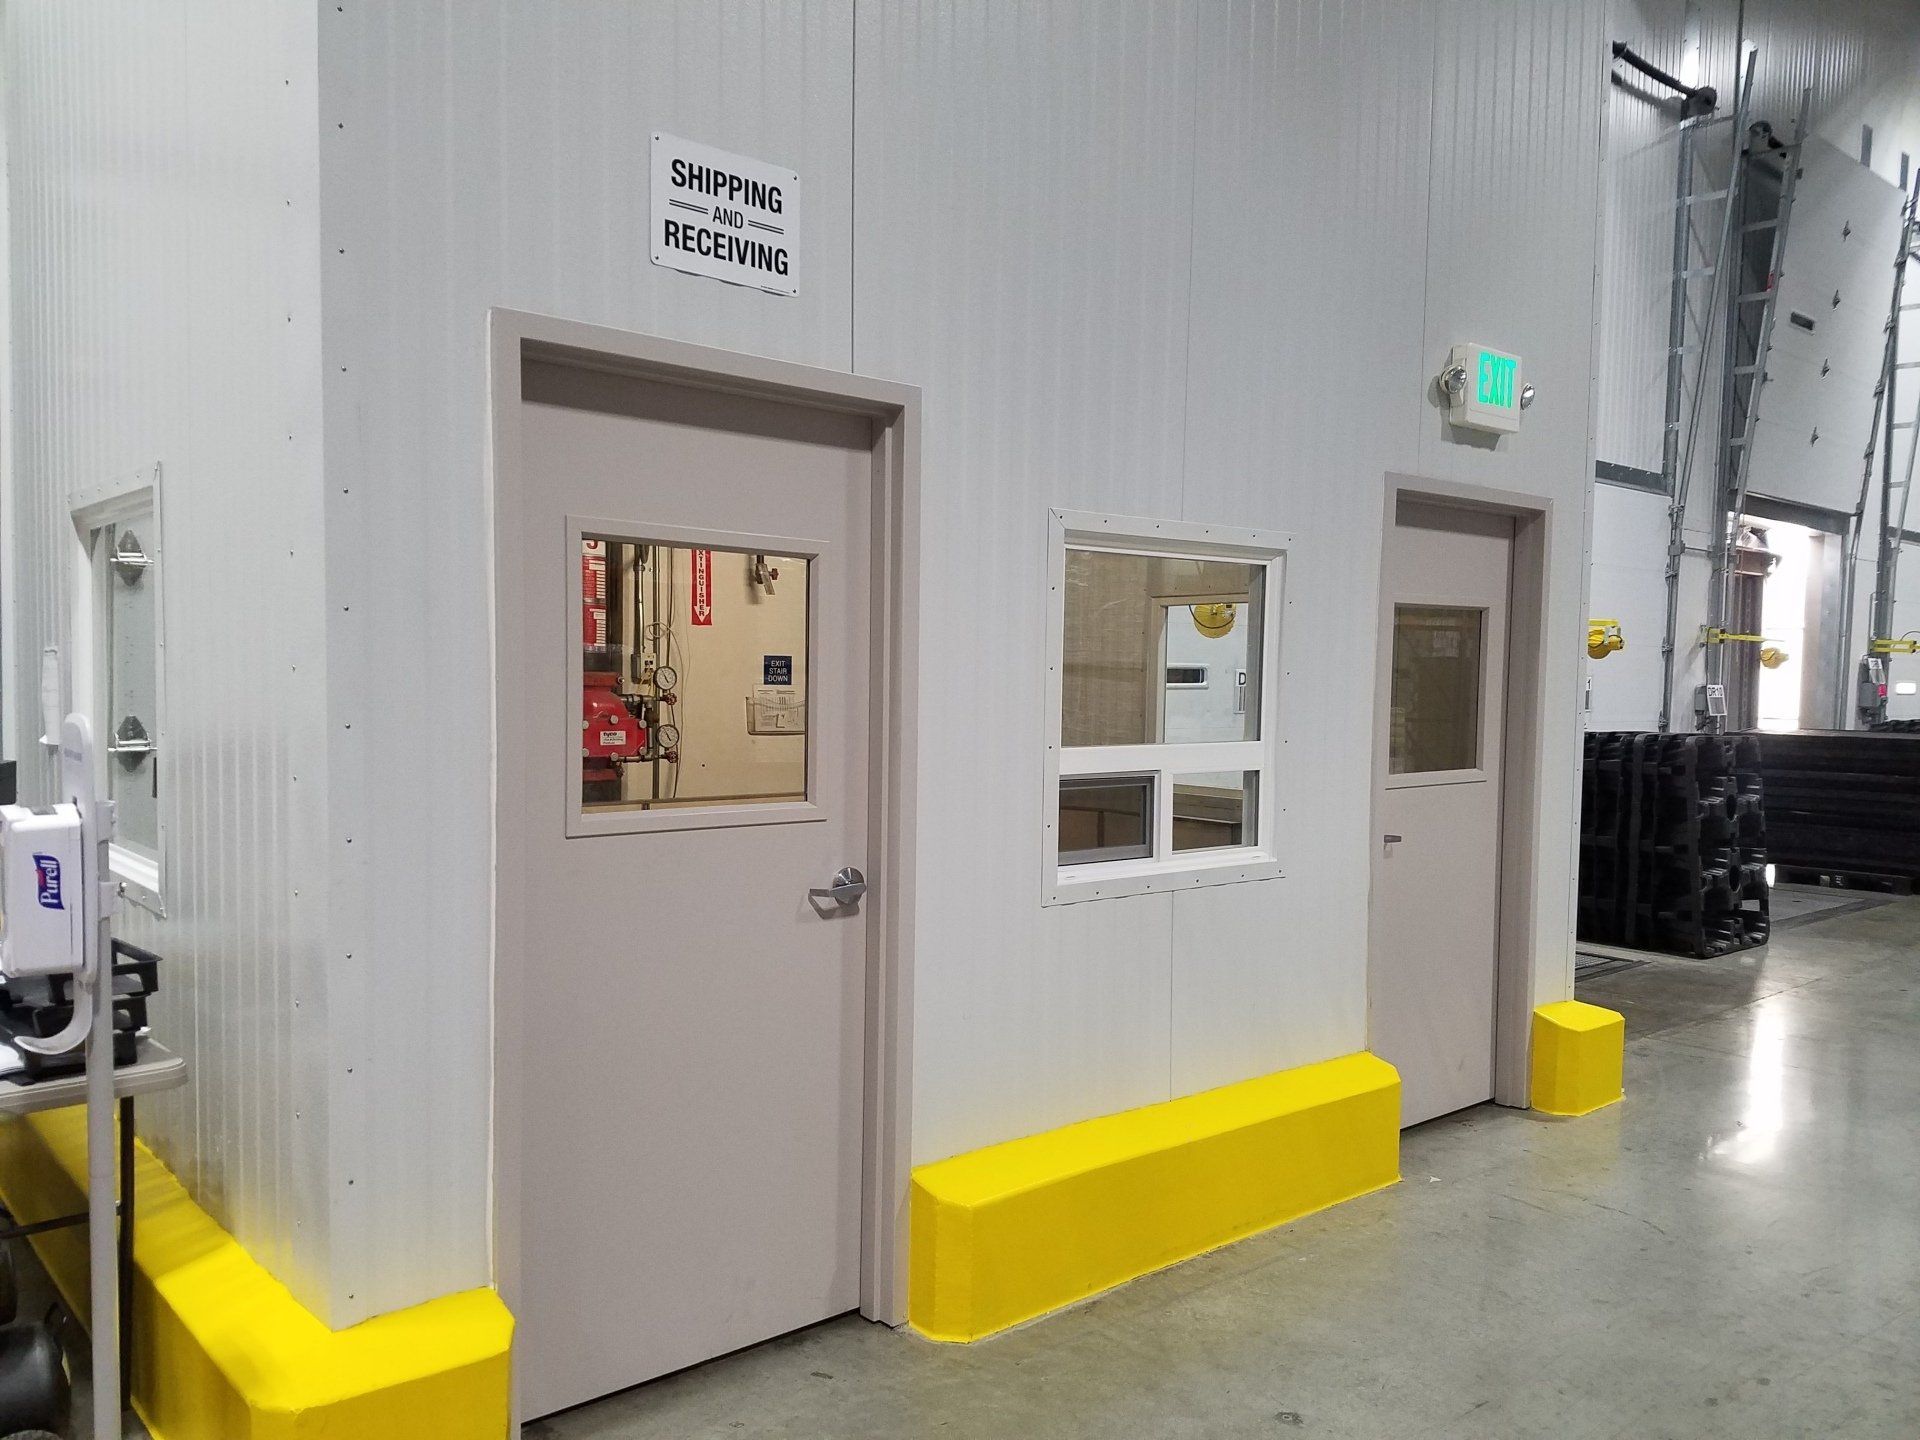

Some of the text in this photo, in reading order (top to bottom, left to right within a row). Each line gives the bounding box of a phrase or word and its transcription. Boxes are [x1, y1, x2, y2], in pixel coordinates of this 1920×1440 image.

[671, 158, 782, 215] SHIPPING
[712, 205, 744, 229] AND
[664, 218, 788, 276] RECEIVING
[1479, 351, 1517, 408] EXIT
[767, 674, 789, 682] DOWN
[768, 667, 788, 675] STAIR
[770, 660, 787, 668] EXIT
[40, 859, 58, 903] Purell
